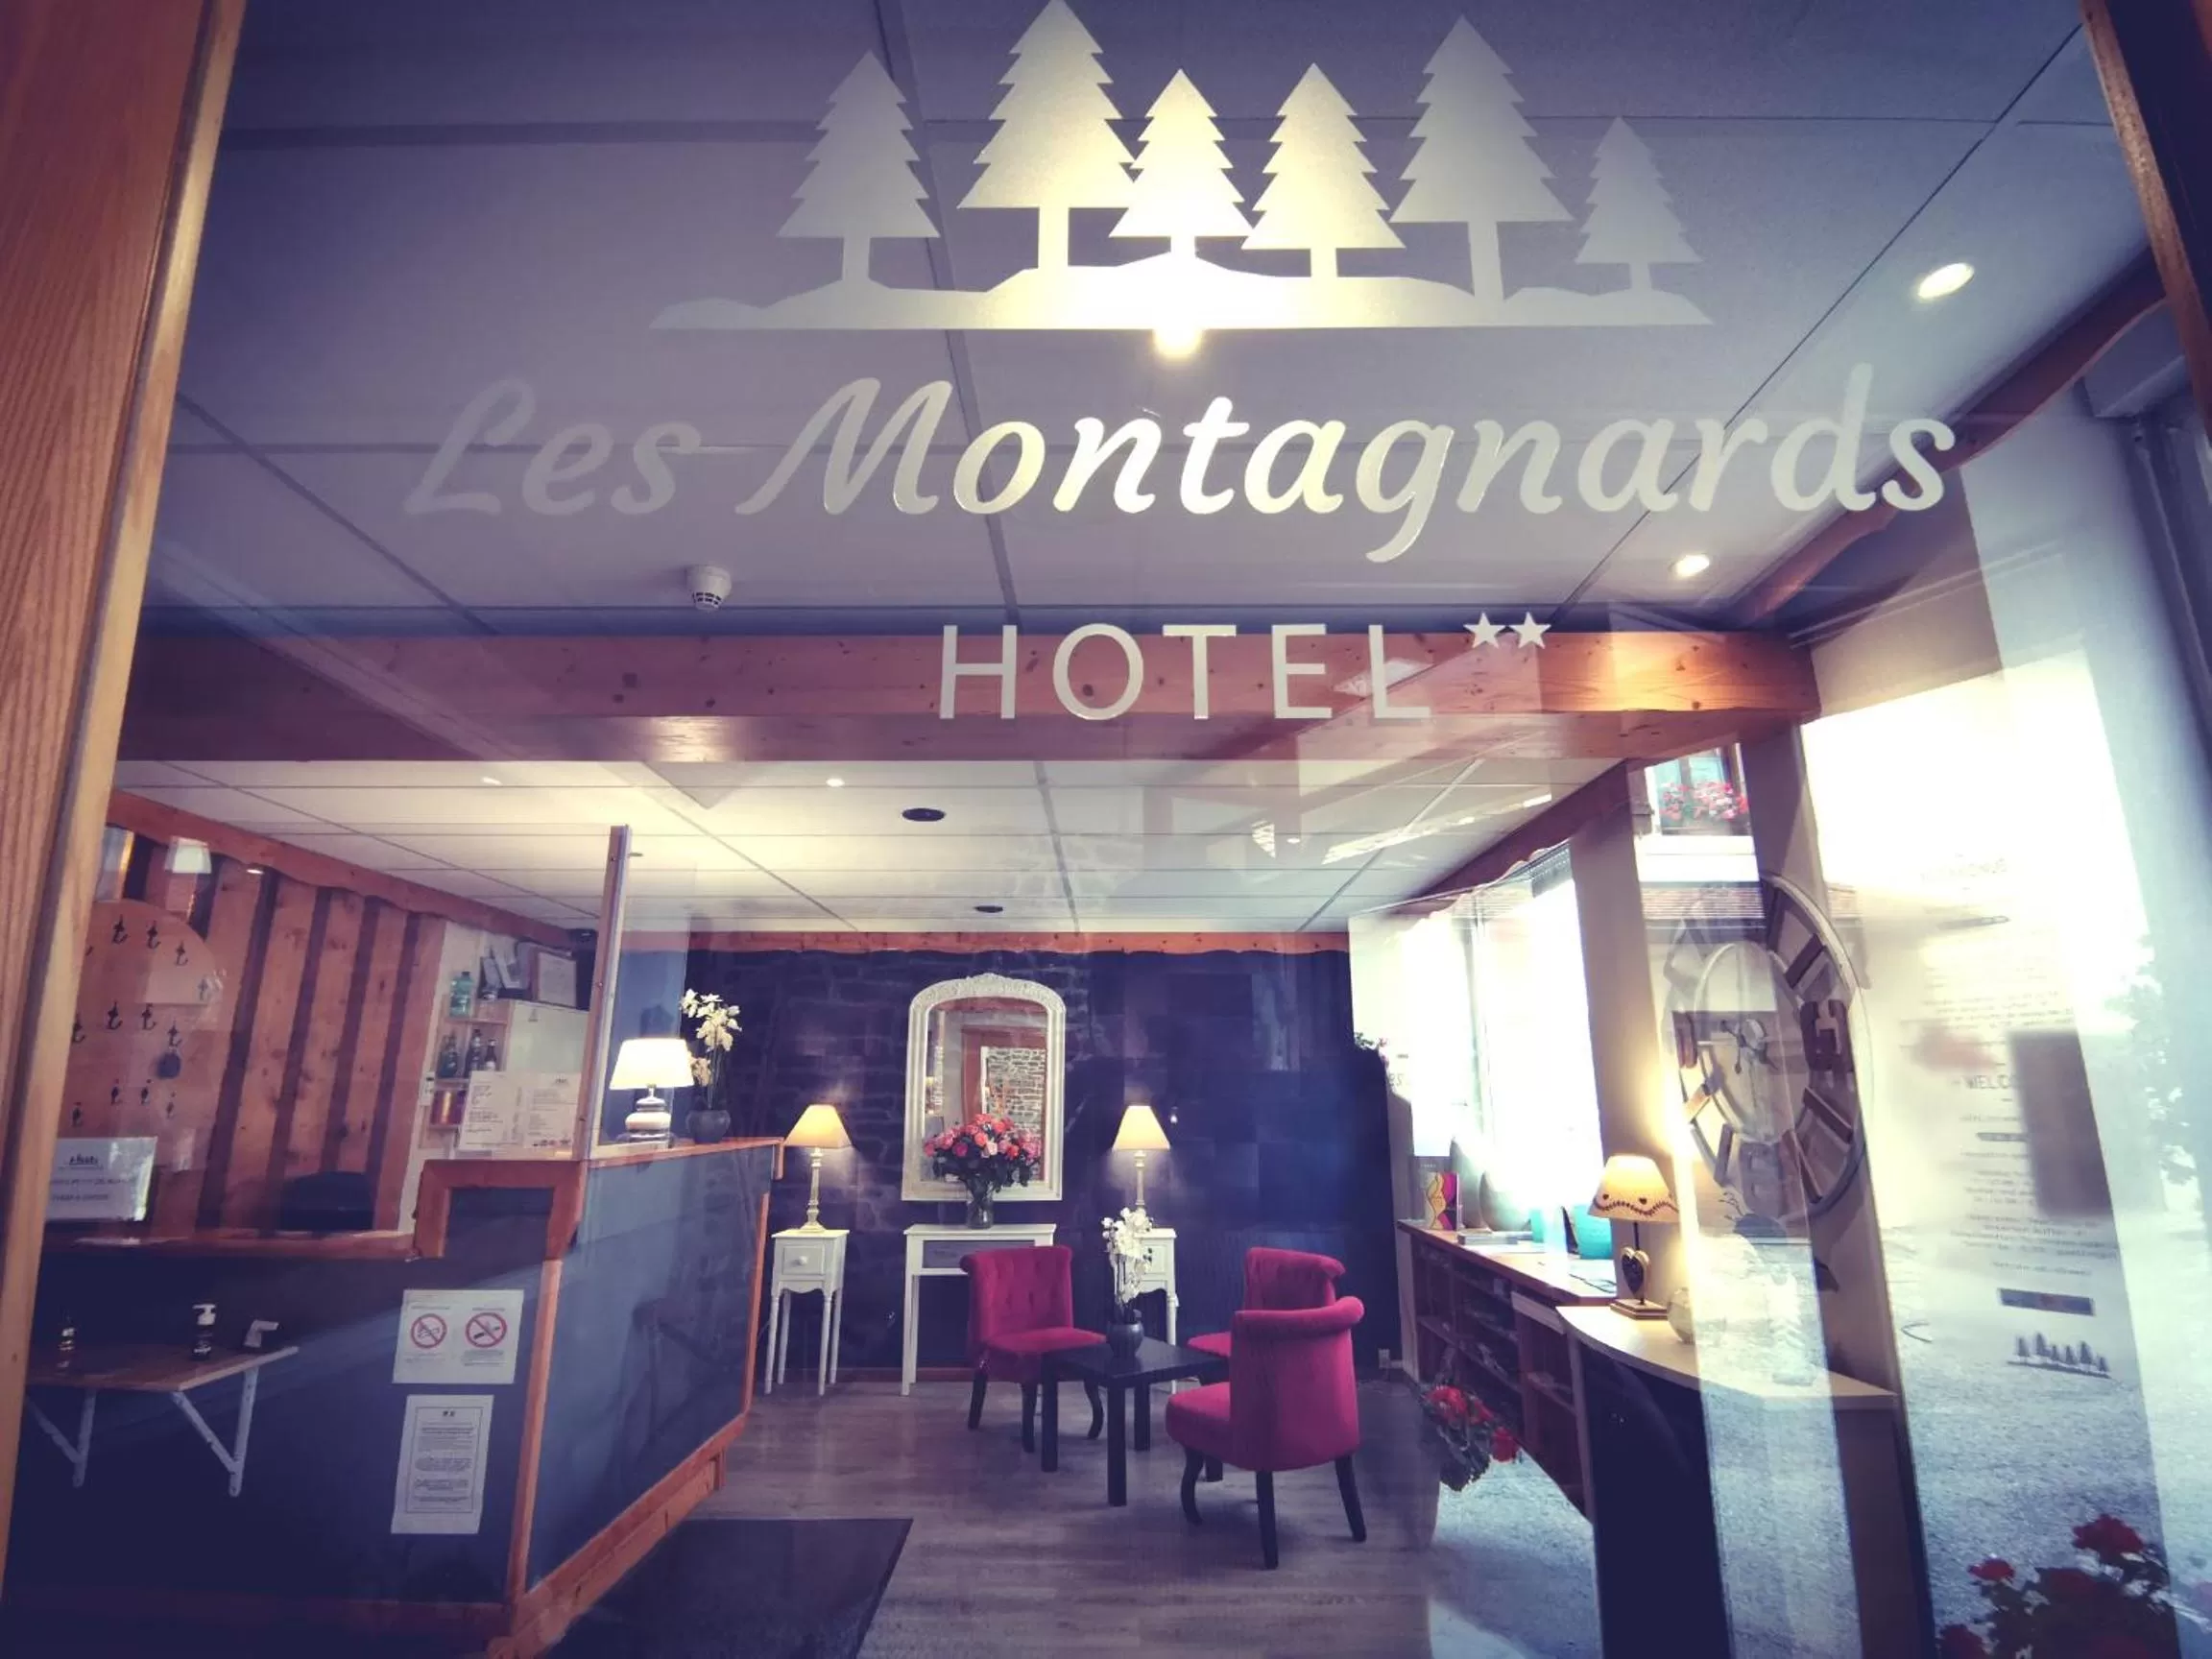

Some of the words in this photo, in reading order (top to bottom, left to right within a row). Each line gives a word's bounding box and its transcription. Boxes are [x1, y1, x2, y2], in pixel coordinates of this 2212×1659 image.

[403, 377, 704, 517] Les
[734, 362, 1956, 564] Montagnards
[938, 622, 1431, 722] HOTEL
